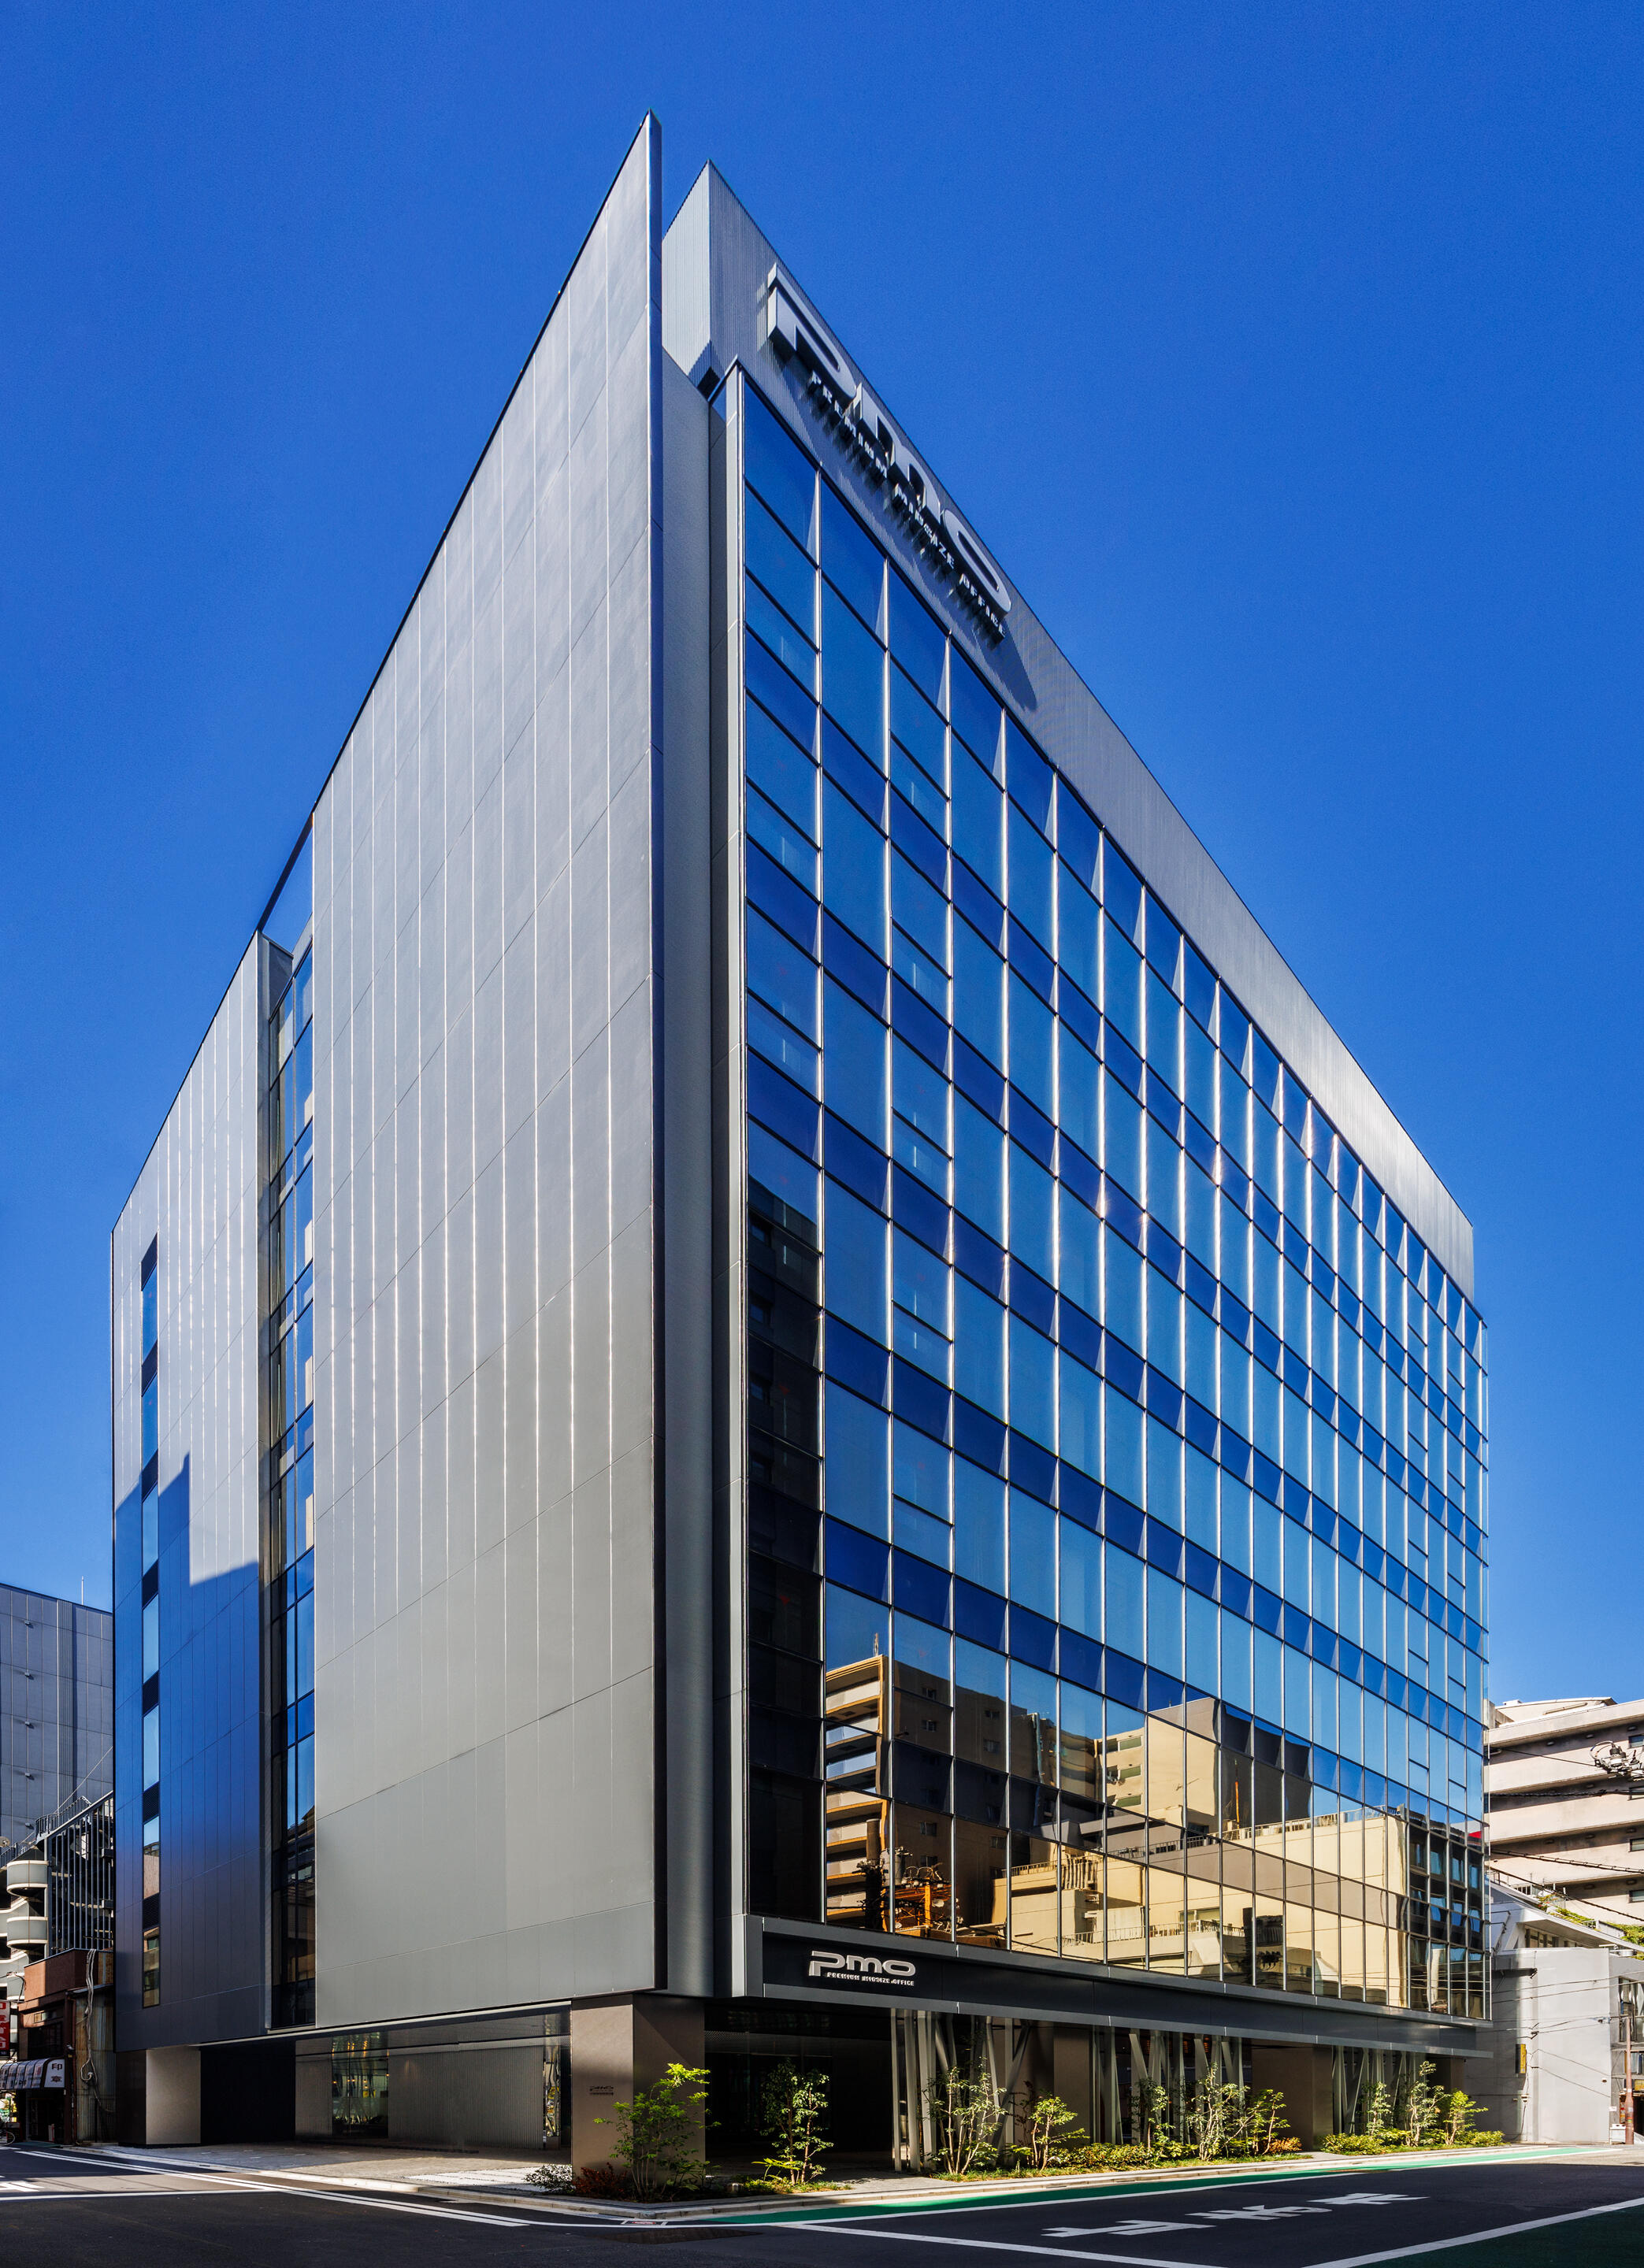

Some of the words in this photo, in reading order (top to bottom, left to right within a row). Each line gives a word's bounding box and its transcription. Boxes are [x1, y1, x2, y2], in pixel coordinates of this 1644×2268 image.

[810, 369, 888, 479] PREMIUM
[893, 483, 955, 570] MIDSIZE
[959, 573, 1006, 639] OFFICE
[827, 1972, 860, 1981] PREMIUM
[862, 1975, 890, 1984] MIDSIZE
[1041, 2192, 1430, 2237] 止まれ
